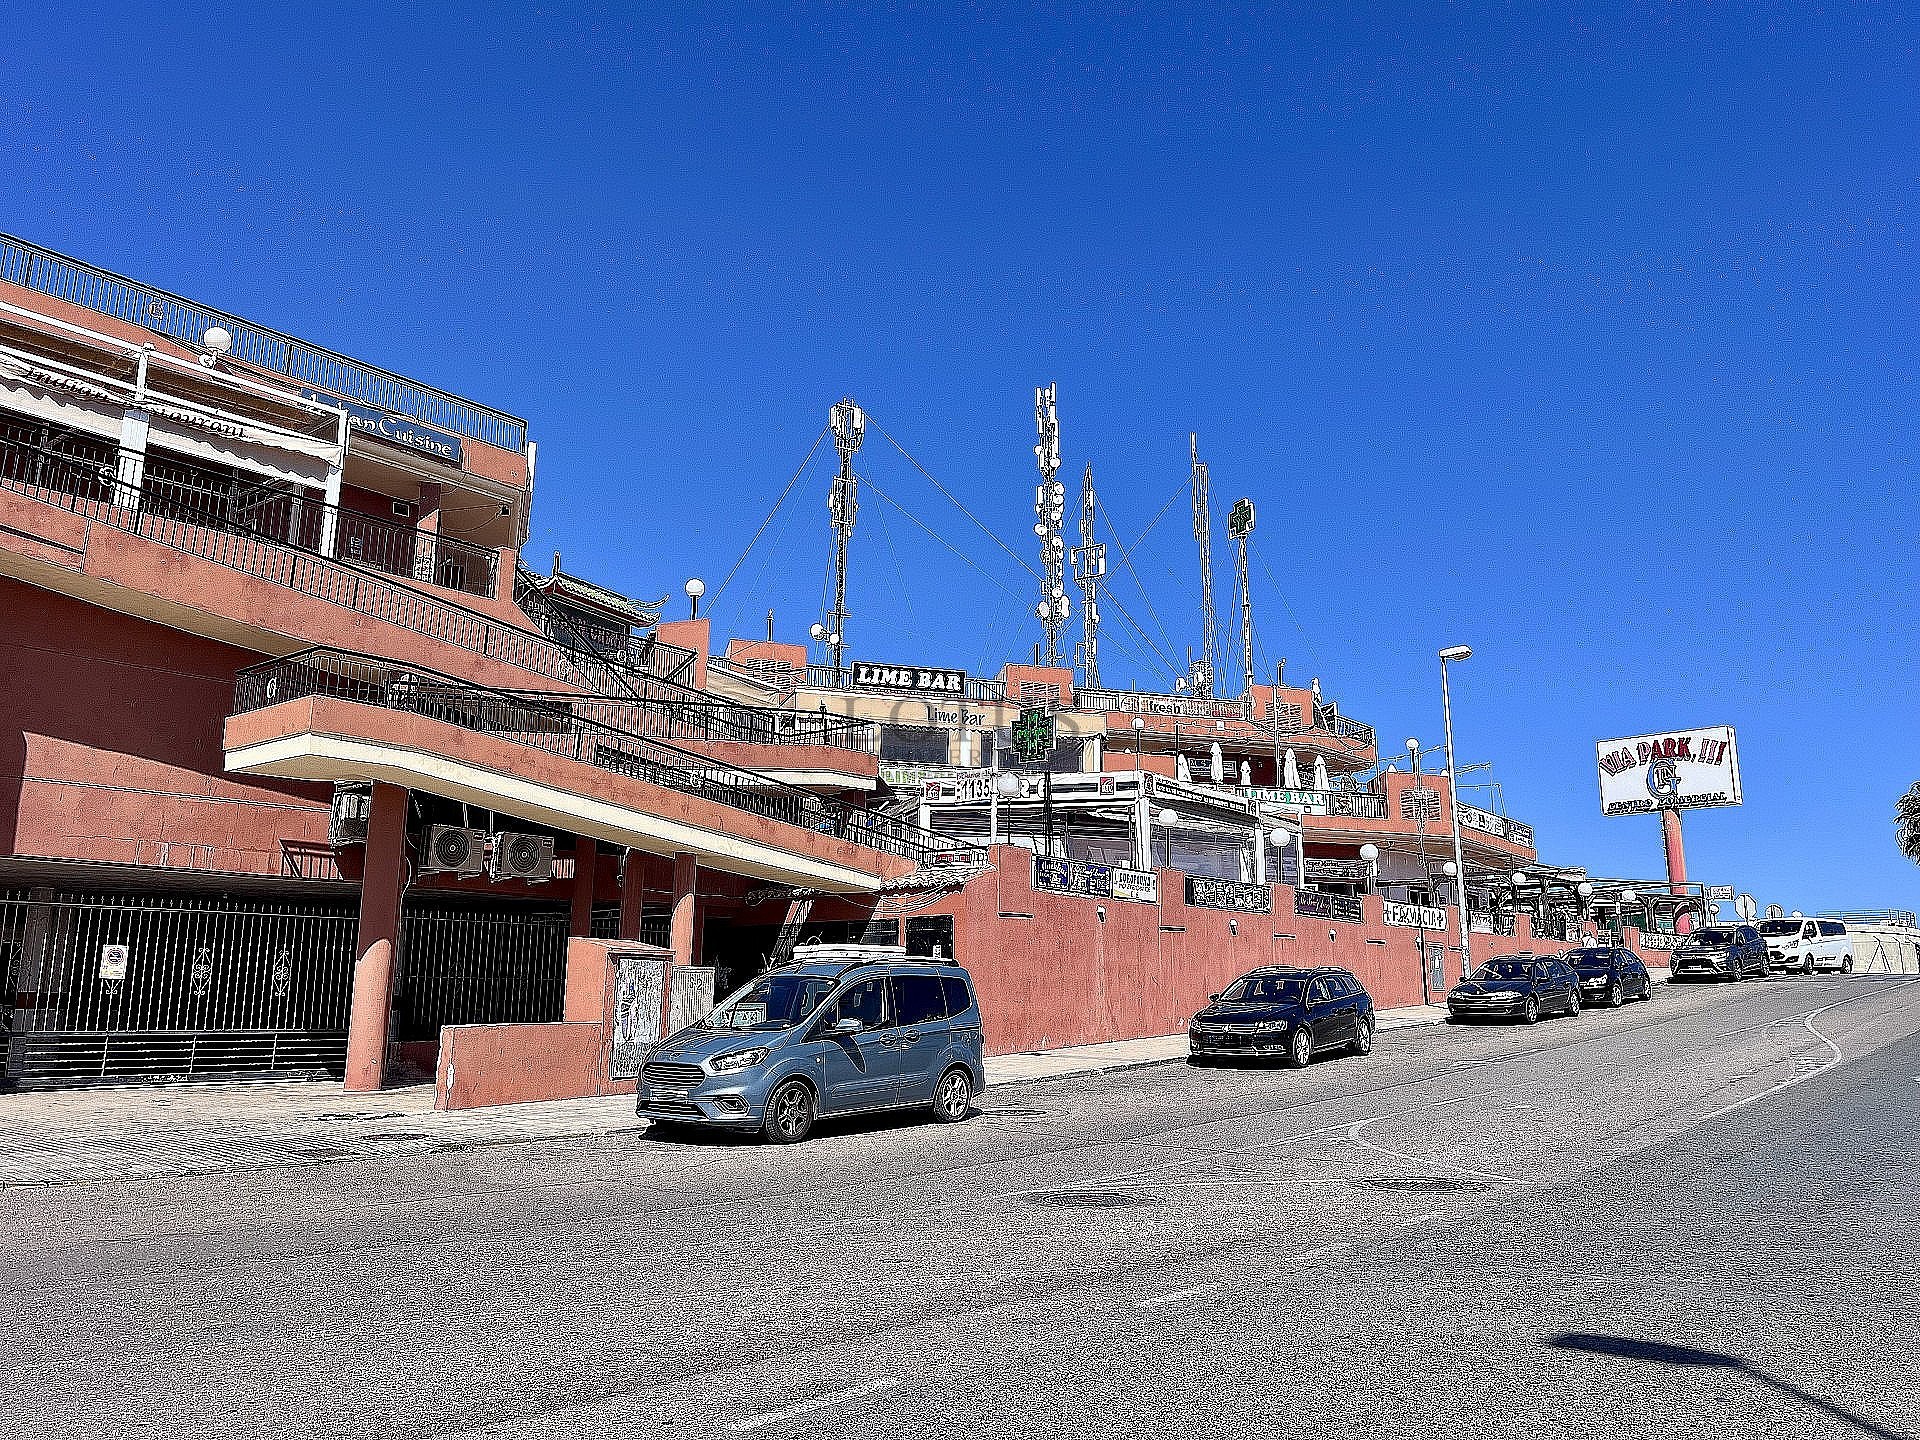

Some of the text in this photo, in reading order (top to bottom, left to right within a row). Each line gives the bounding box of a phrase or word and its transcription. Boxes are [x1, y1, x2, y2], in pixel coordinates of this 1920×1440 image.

[378, 416, 453, 457] Cuisine
[856, 666, 962, 692] LIME BAR
[926, 705, 986, 726] Lime Bar
[1600, 746, 1637, 777] VIA
[1244, 788, 1286, 802] LIME
[1290, 792, 1325, 805] BAR
